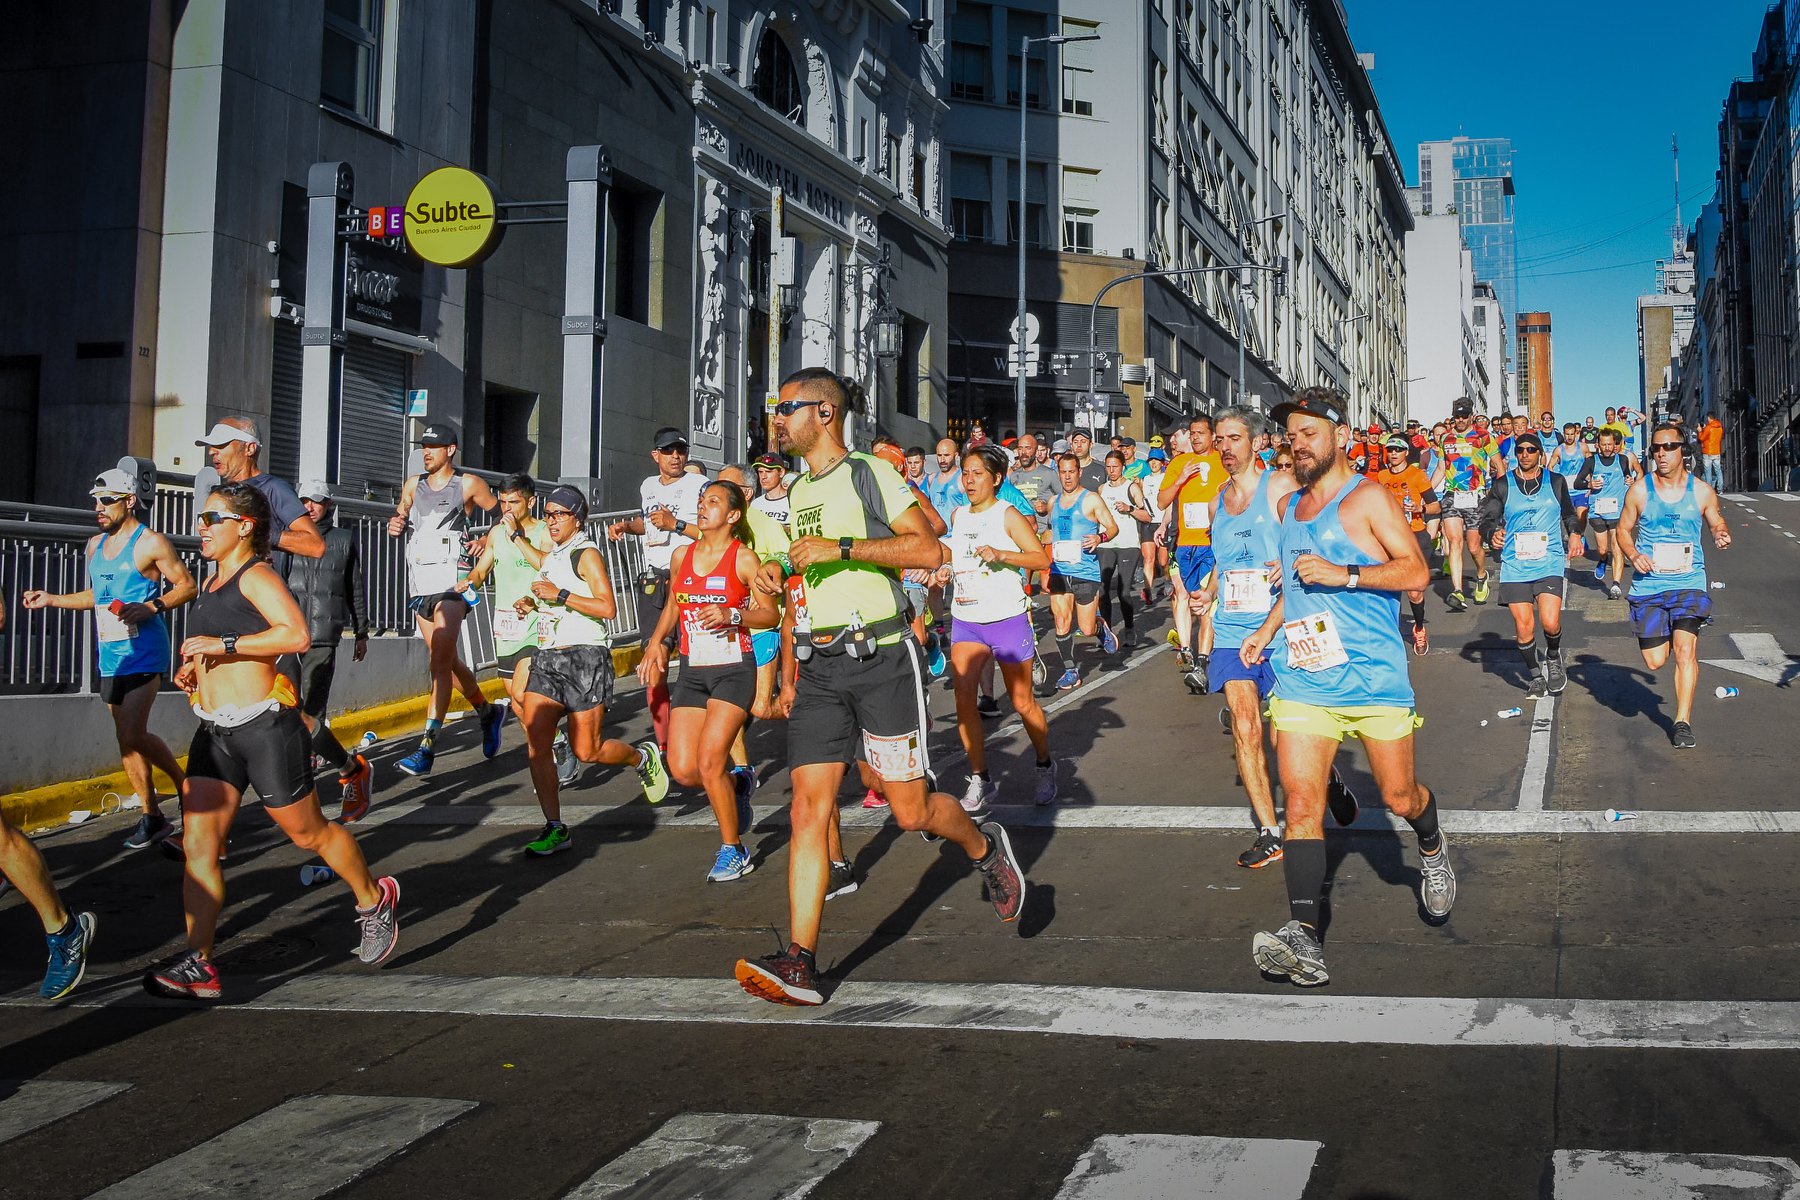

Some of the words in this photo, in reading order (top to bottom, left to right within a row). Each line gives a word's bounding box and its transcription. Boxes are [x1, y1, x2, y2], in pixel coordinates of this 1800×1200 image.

[372, 214, 382, 230] B
[391, 214, 400, 229] E
[416, 201, 481, 224] Subte
[142, 471, 152, 493] S
[796, 508, 823, 527] CORRE
[868, 748, 917, 769] 13326
[185, 966, 202, 982] N
